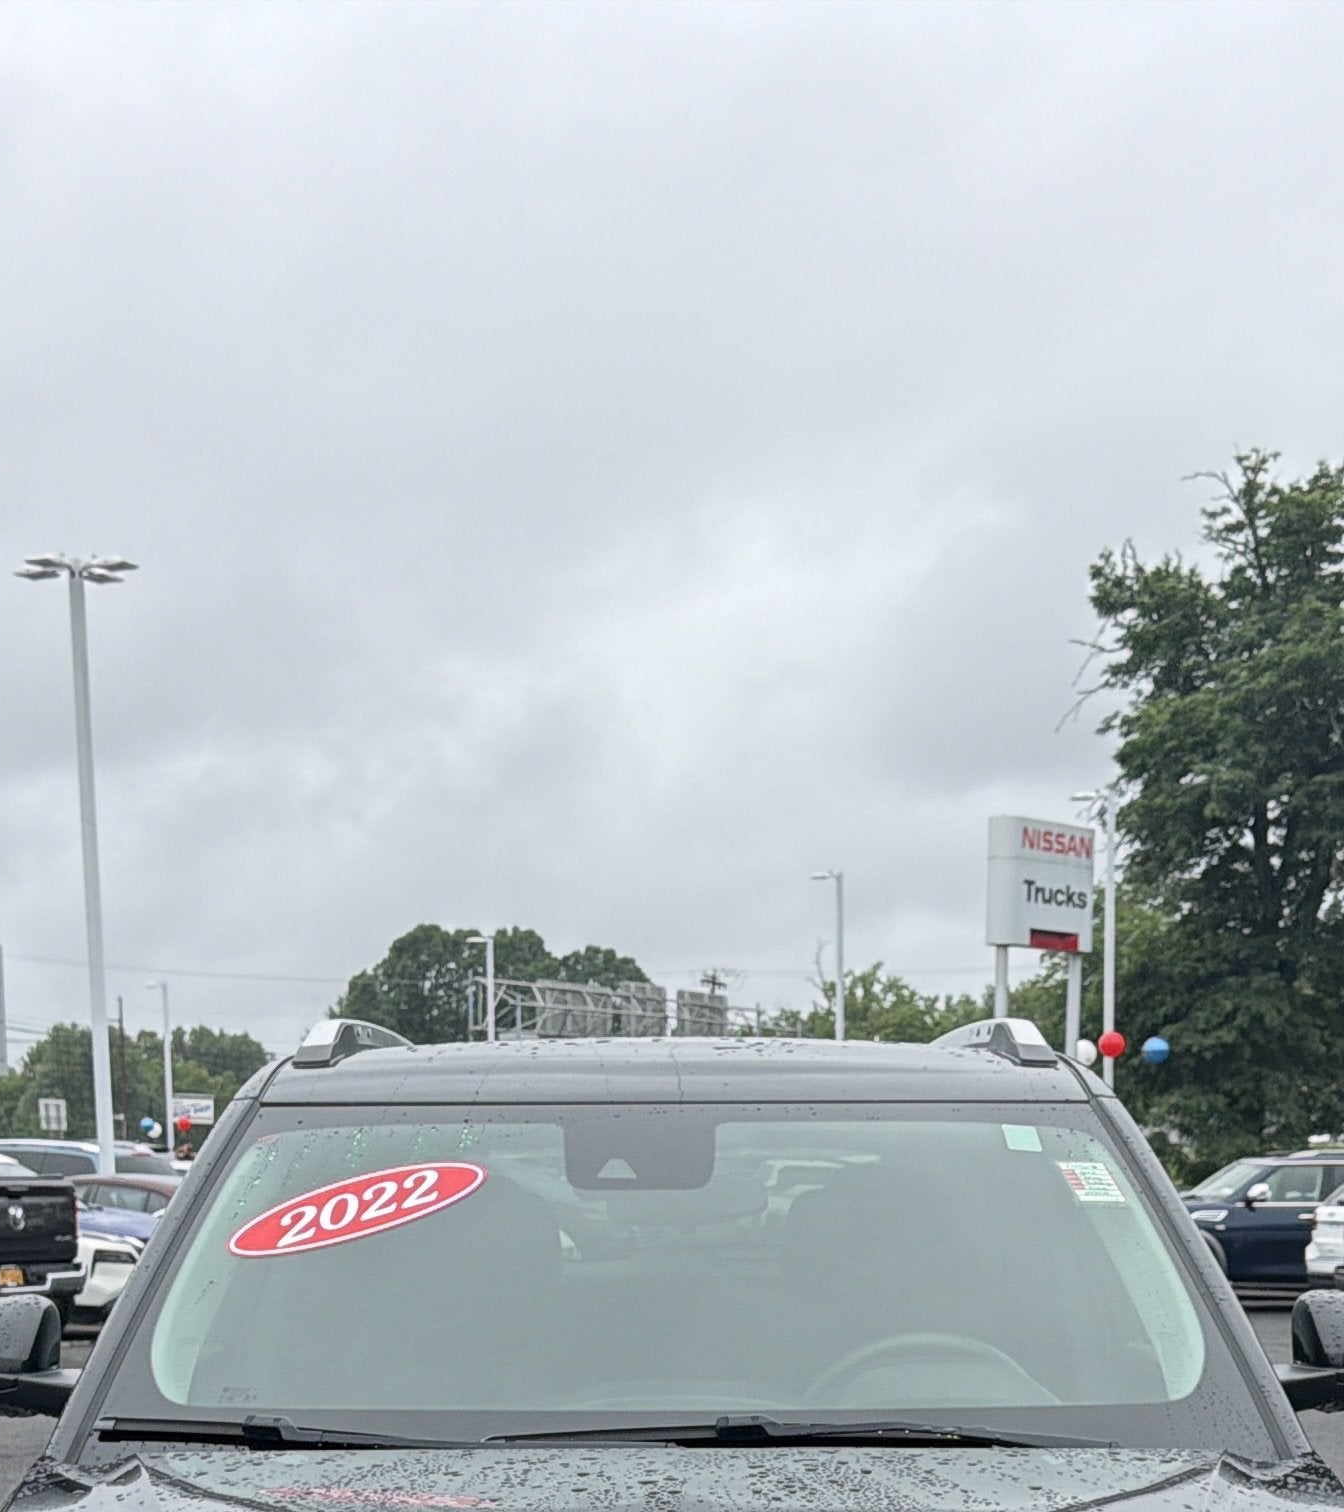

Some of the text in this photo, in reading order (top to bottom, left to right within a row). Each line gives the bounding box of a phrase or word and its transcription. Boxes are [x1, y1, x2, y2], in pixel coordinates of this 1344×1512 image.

[1022, 826, 1093, 860] NISSAN
[1023, 879, 1088, 909] Trucks
[275, 1168, 440, 1248] 2022
